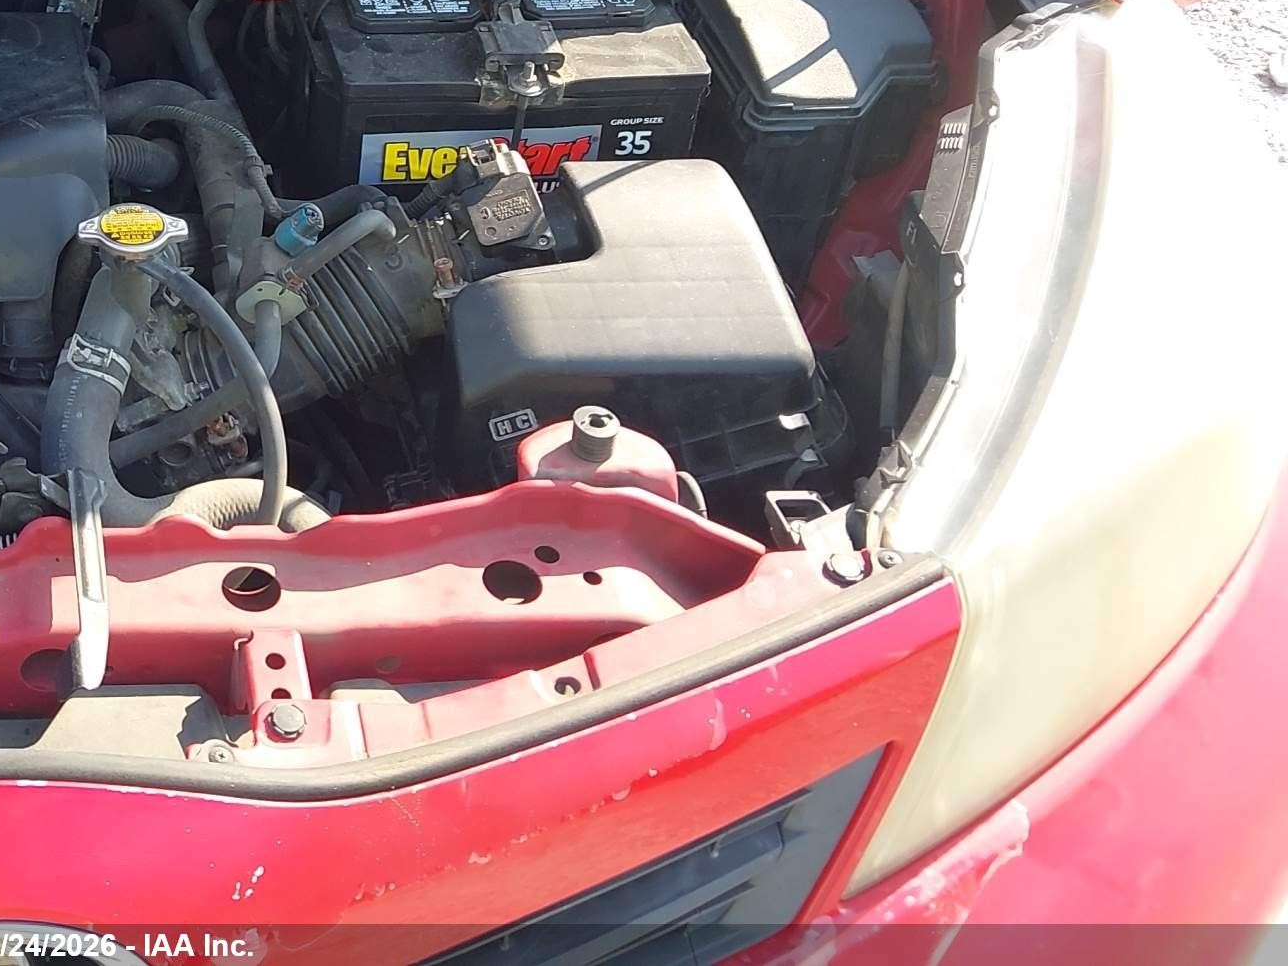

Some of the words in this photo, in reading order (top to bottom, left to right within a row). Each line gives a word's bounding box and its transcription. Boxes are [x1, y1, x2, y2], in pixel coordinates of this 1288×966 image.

[610, 118, 643, 126] GROUP
[615, 130, 653, 155] 35
[496, 415, 530, 436] HC
